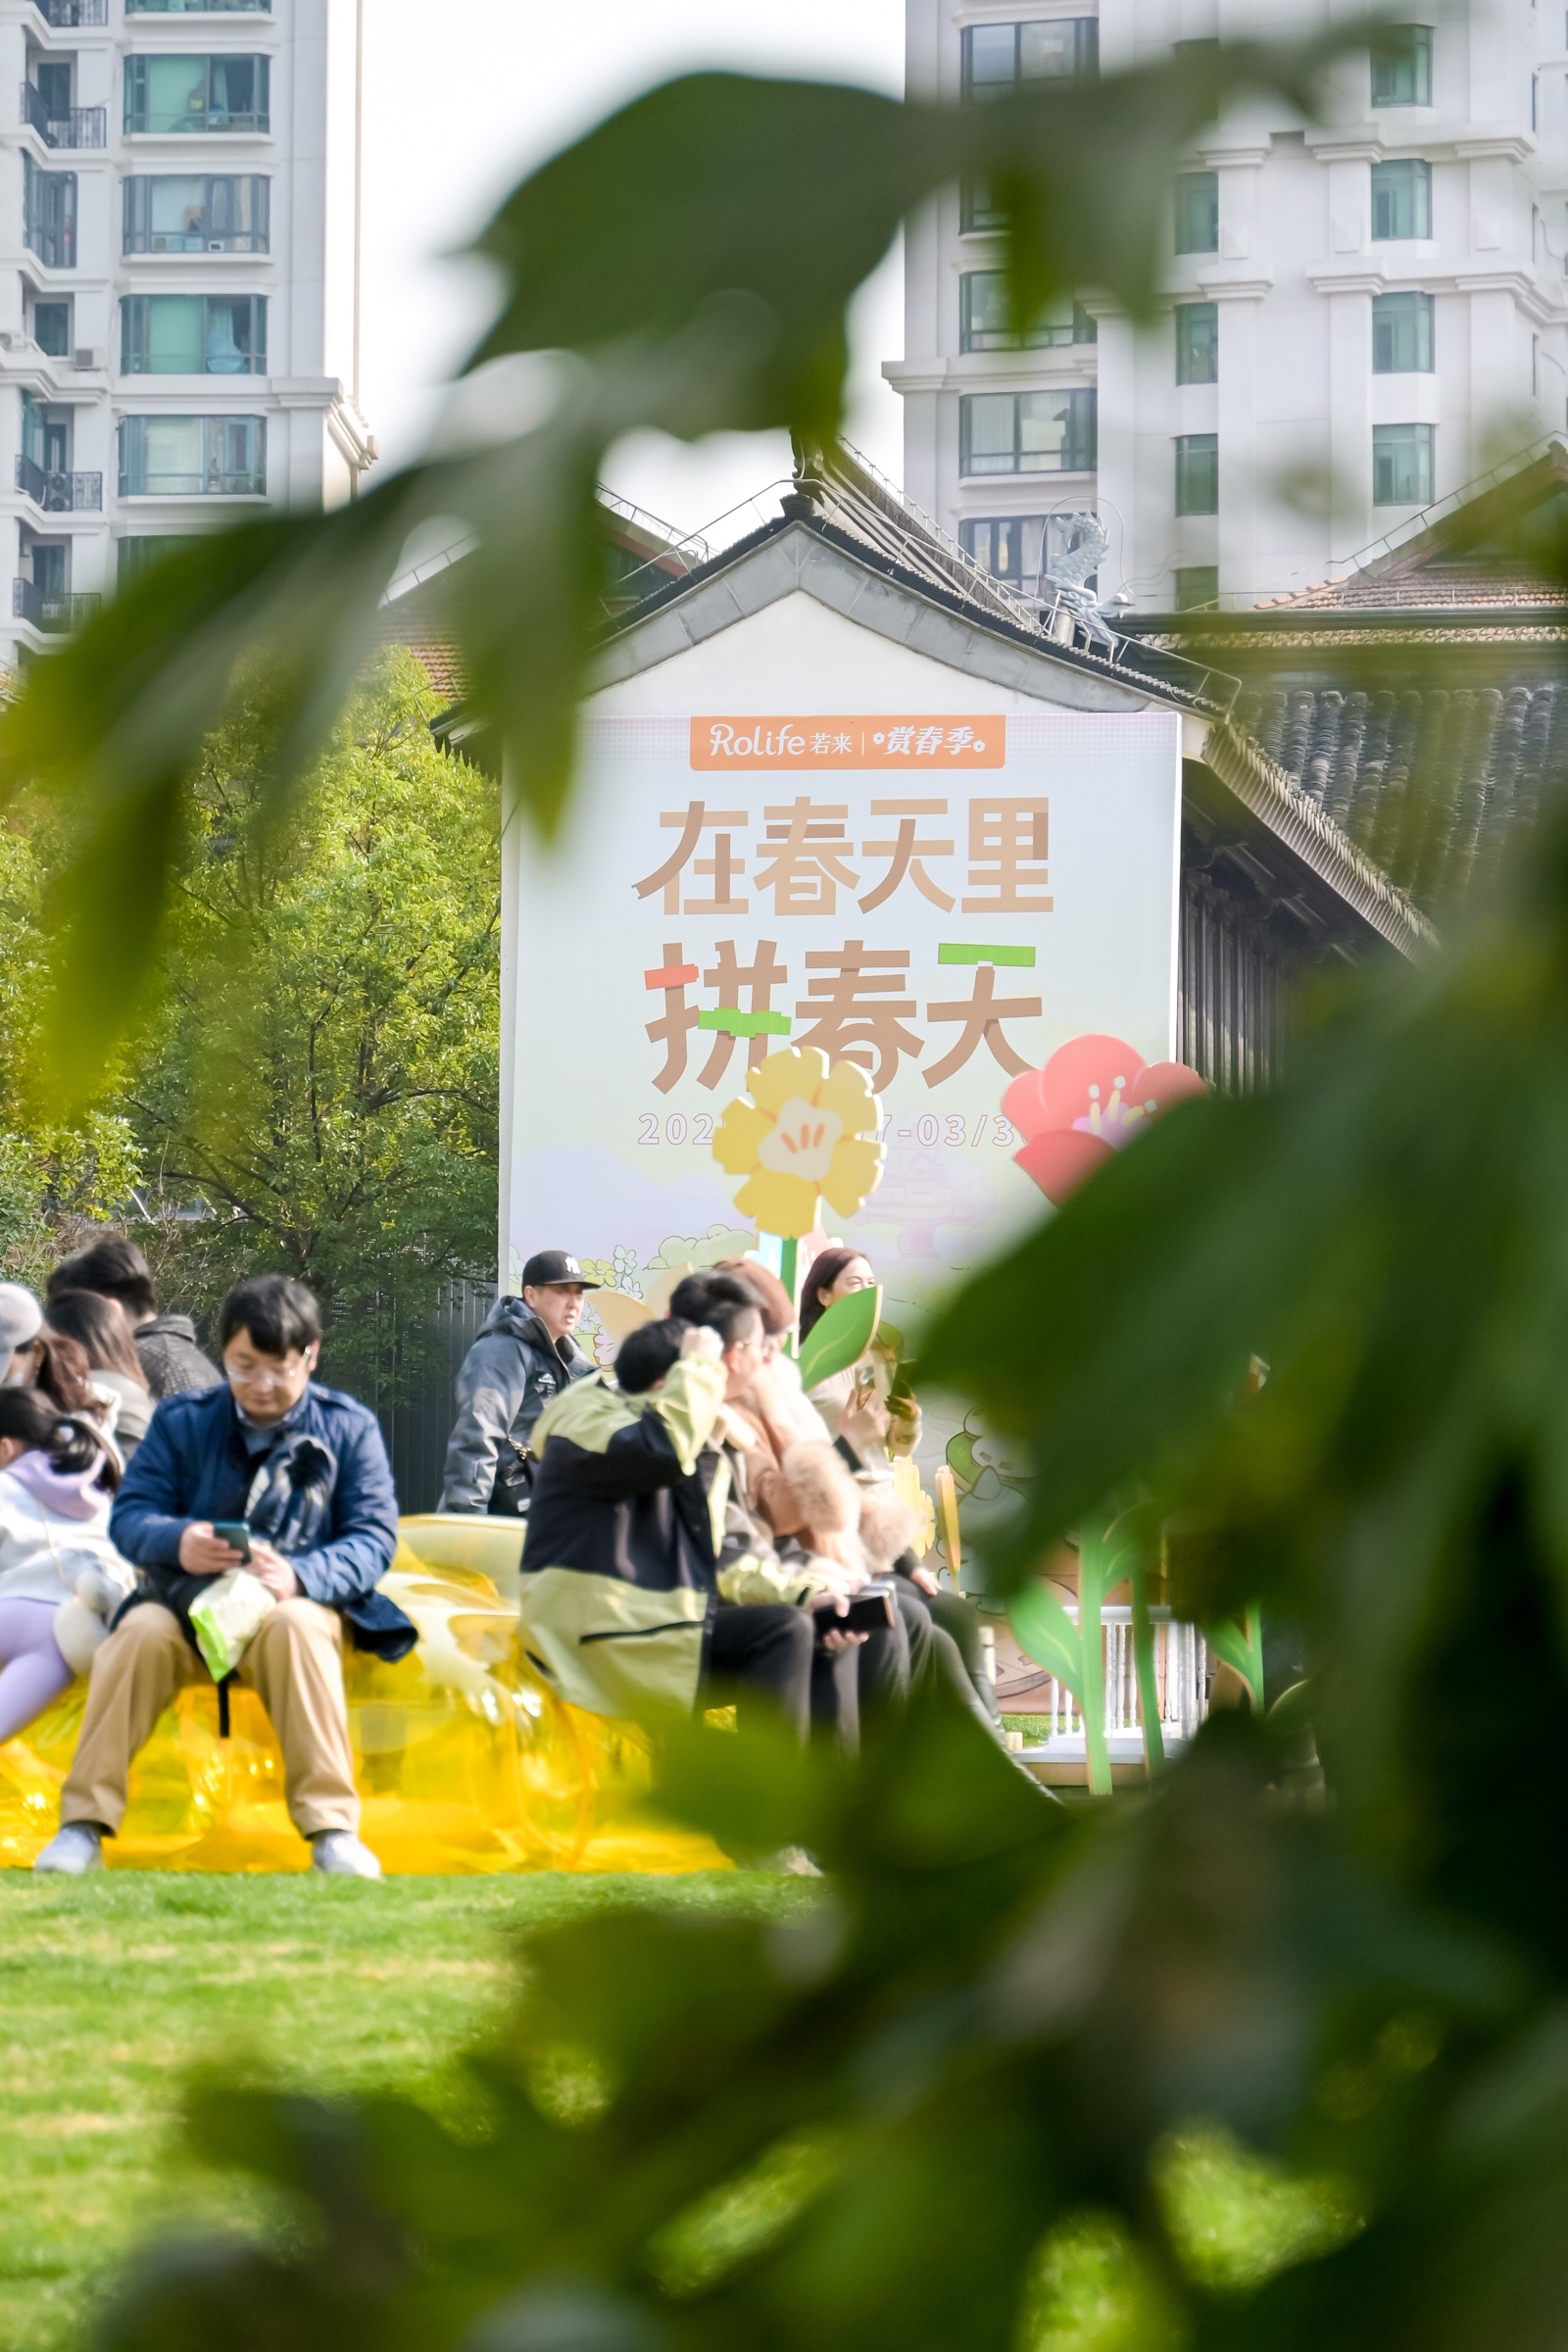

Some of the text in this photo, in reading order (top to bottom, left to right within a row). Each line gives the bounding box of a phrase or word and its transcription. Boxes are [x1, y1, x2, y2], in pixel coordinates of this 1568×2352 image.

[710, 723, 974, 756] Rolife 若来 赏春季
[631, 796, 1054, 914] 在春天里
[644, 939, 1043, 1095] 拼春天
